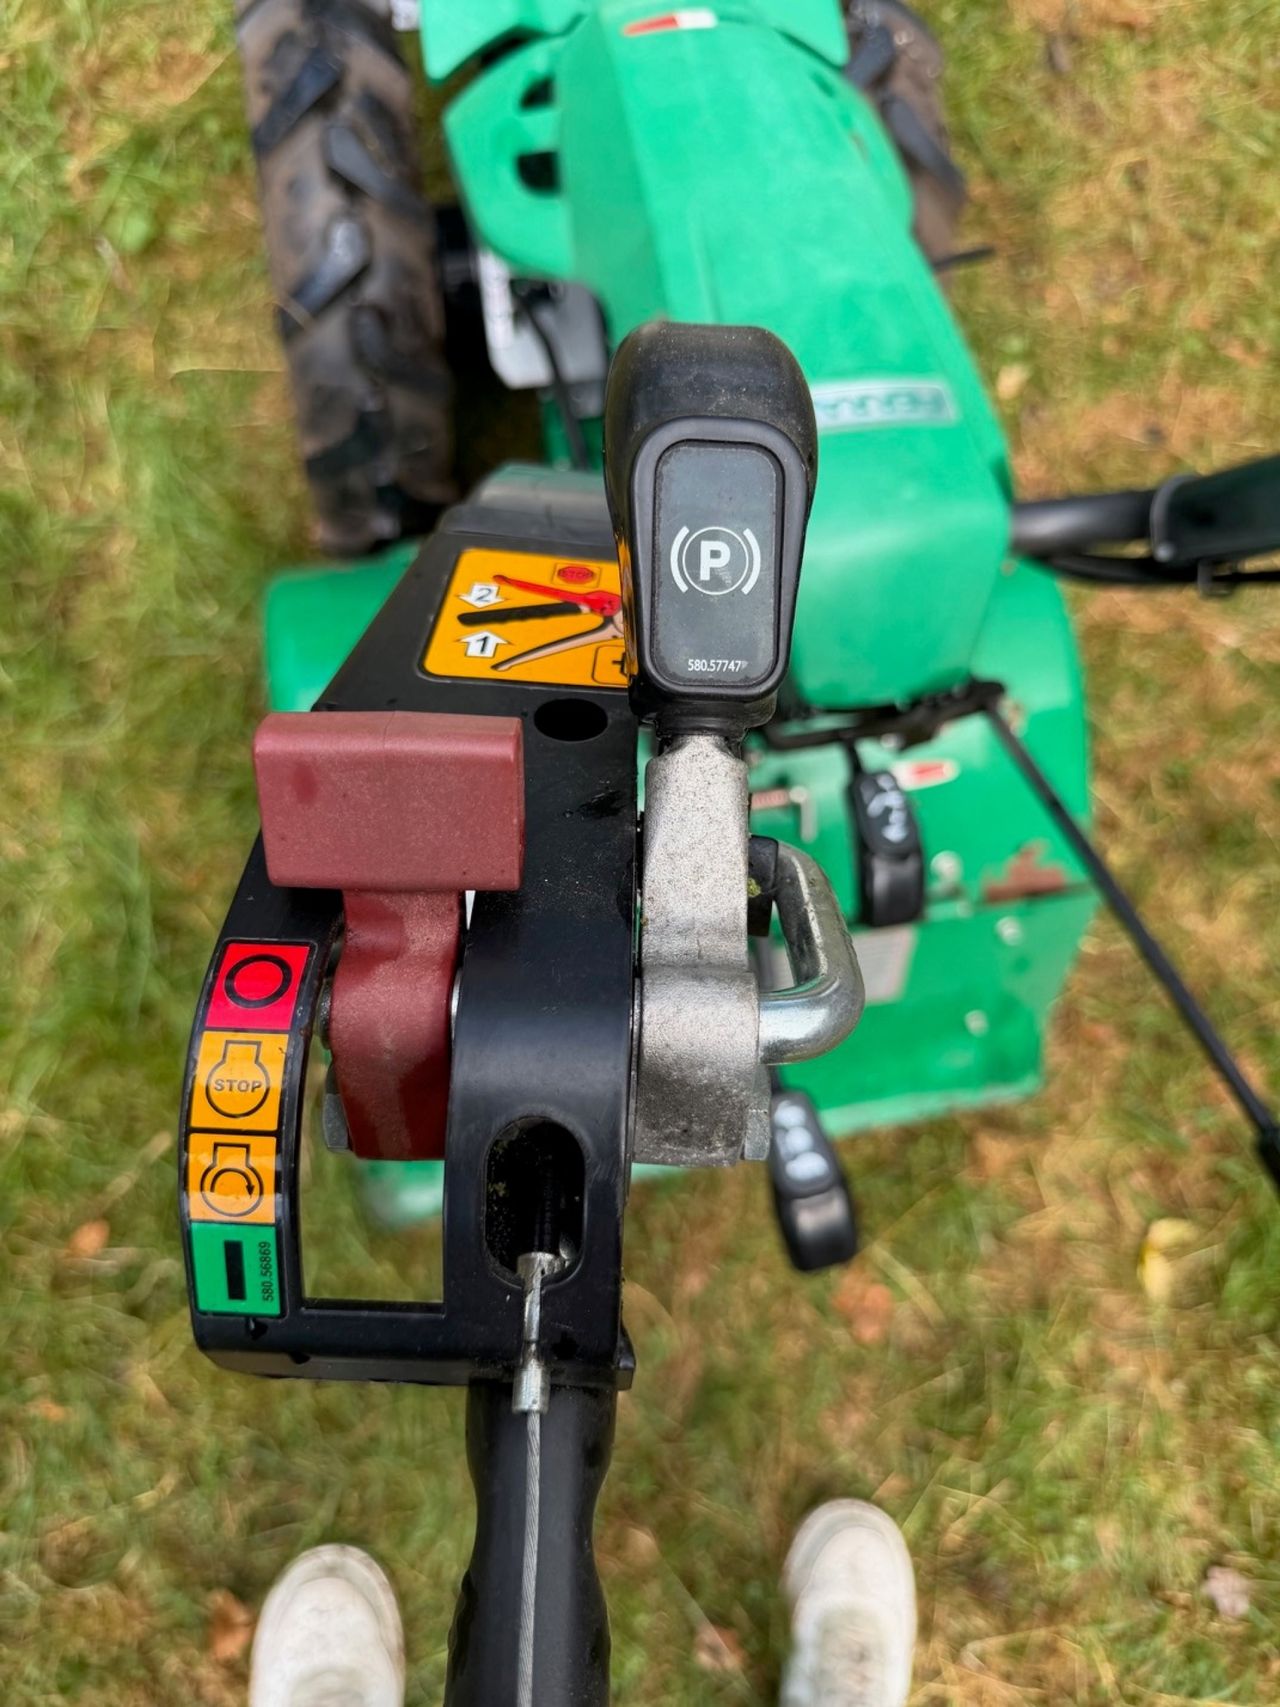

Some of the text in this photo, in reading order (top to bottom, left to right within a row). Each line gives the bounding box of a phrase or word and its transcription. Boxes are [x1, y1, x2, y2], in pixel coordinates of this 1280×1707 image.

[700, 540, 731, 581] P
[475, 587, 493, 602] 2
[476, 635, 490, 654] 1
[687, 658, 742, 673] 580.57747
[214, 1078, 263, 1093] STOP
[258, 1241, 275, 1303] 580.56869
